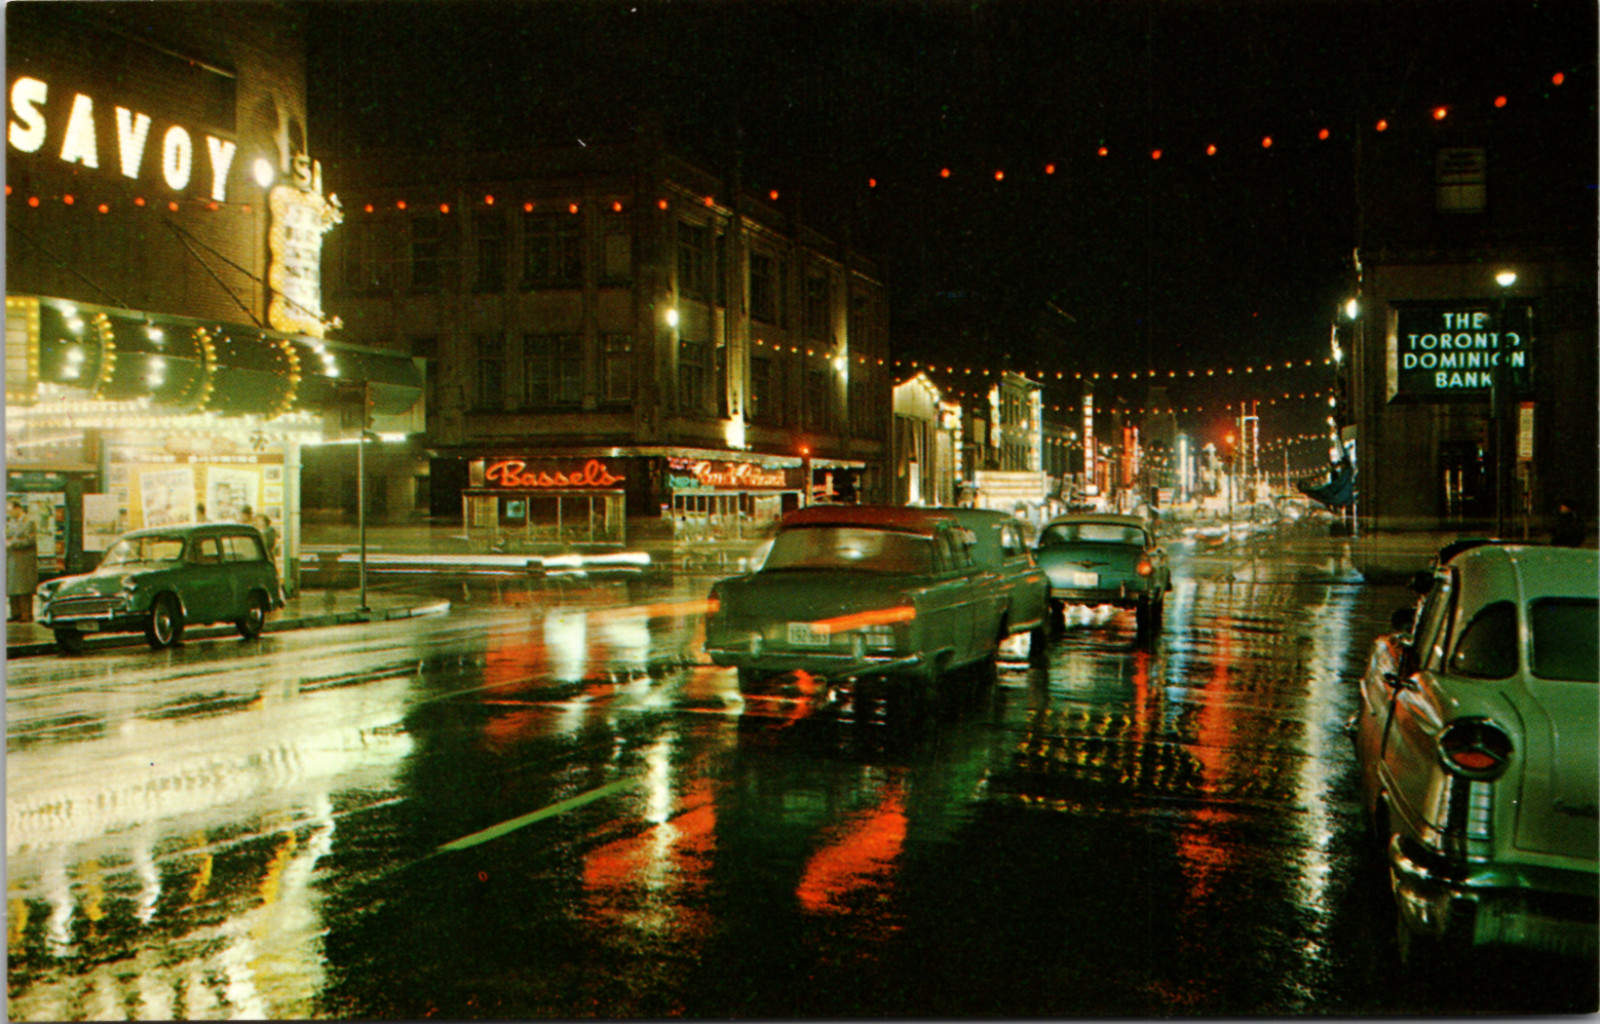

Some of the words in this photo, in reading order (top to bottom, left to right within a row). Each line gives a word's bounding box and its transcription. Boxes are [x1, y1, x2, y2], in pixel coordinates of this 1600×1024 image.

[8, 76, 237, 202] SAVOY
[1442, 312, 1485, 330] THE
[1435, 371, 1493, 389] BANK
[485, 459, 627, 487] Bassel's
